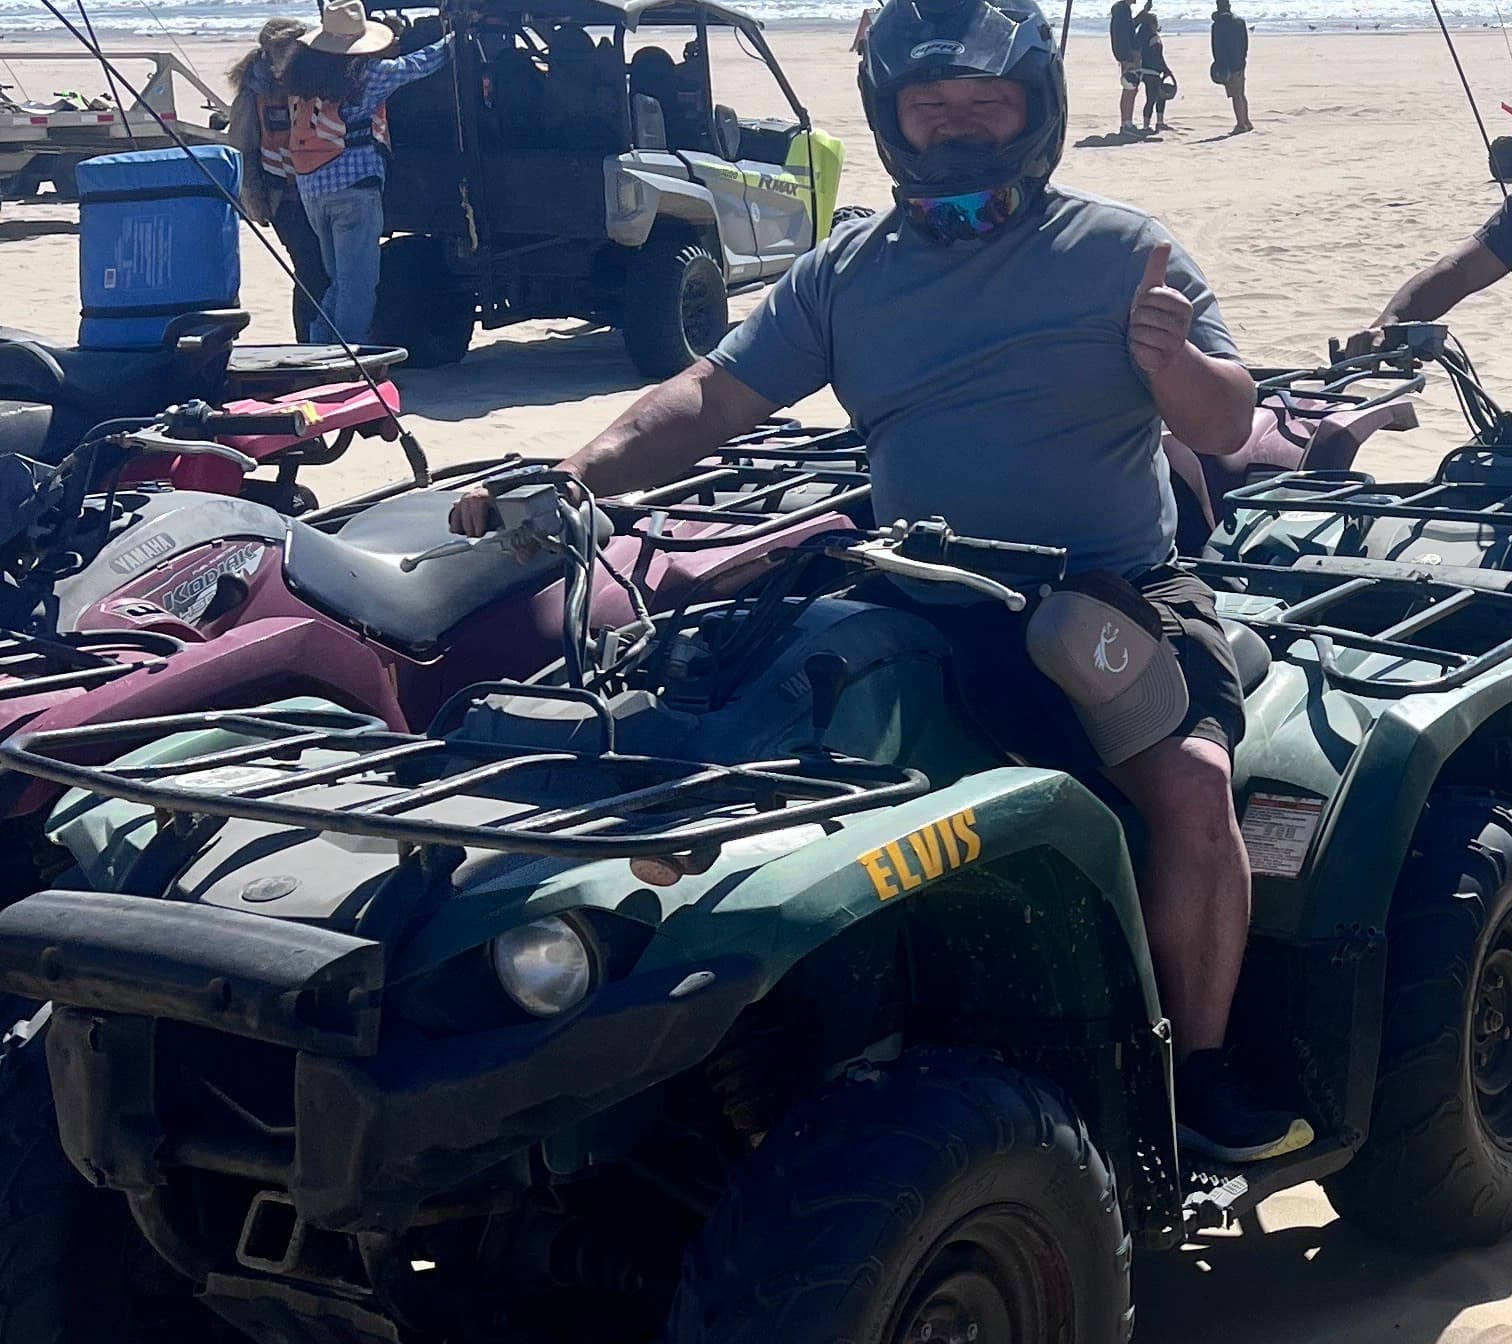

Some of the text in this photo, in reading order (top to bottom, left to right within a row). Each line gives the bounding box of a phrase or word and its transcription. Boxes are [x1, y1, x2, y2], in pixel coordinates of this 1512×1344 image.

[113, 533, 173, 572] YAMAHA
[162, 542, 257, 609] KODIAK
[856, 805, 981, 901] ELVIS
